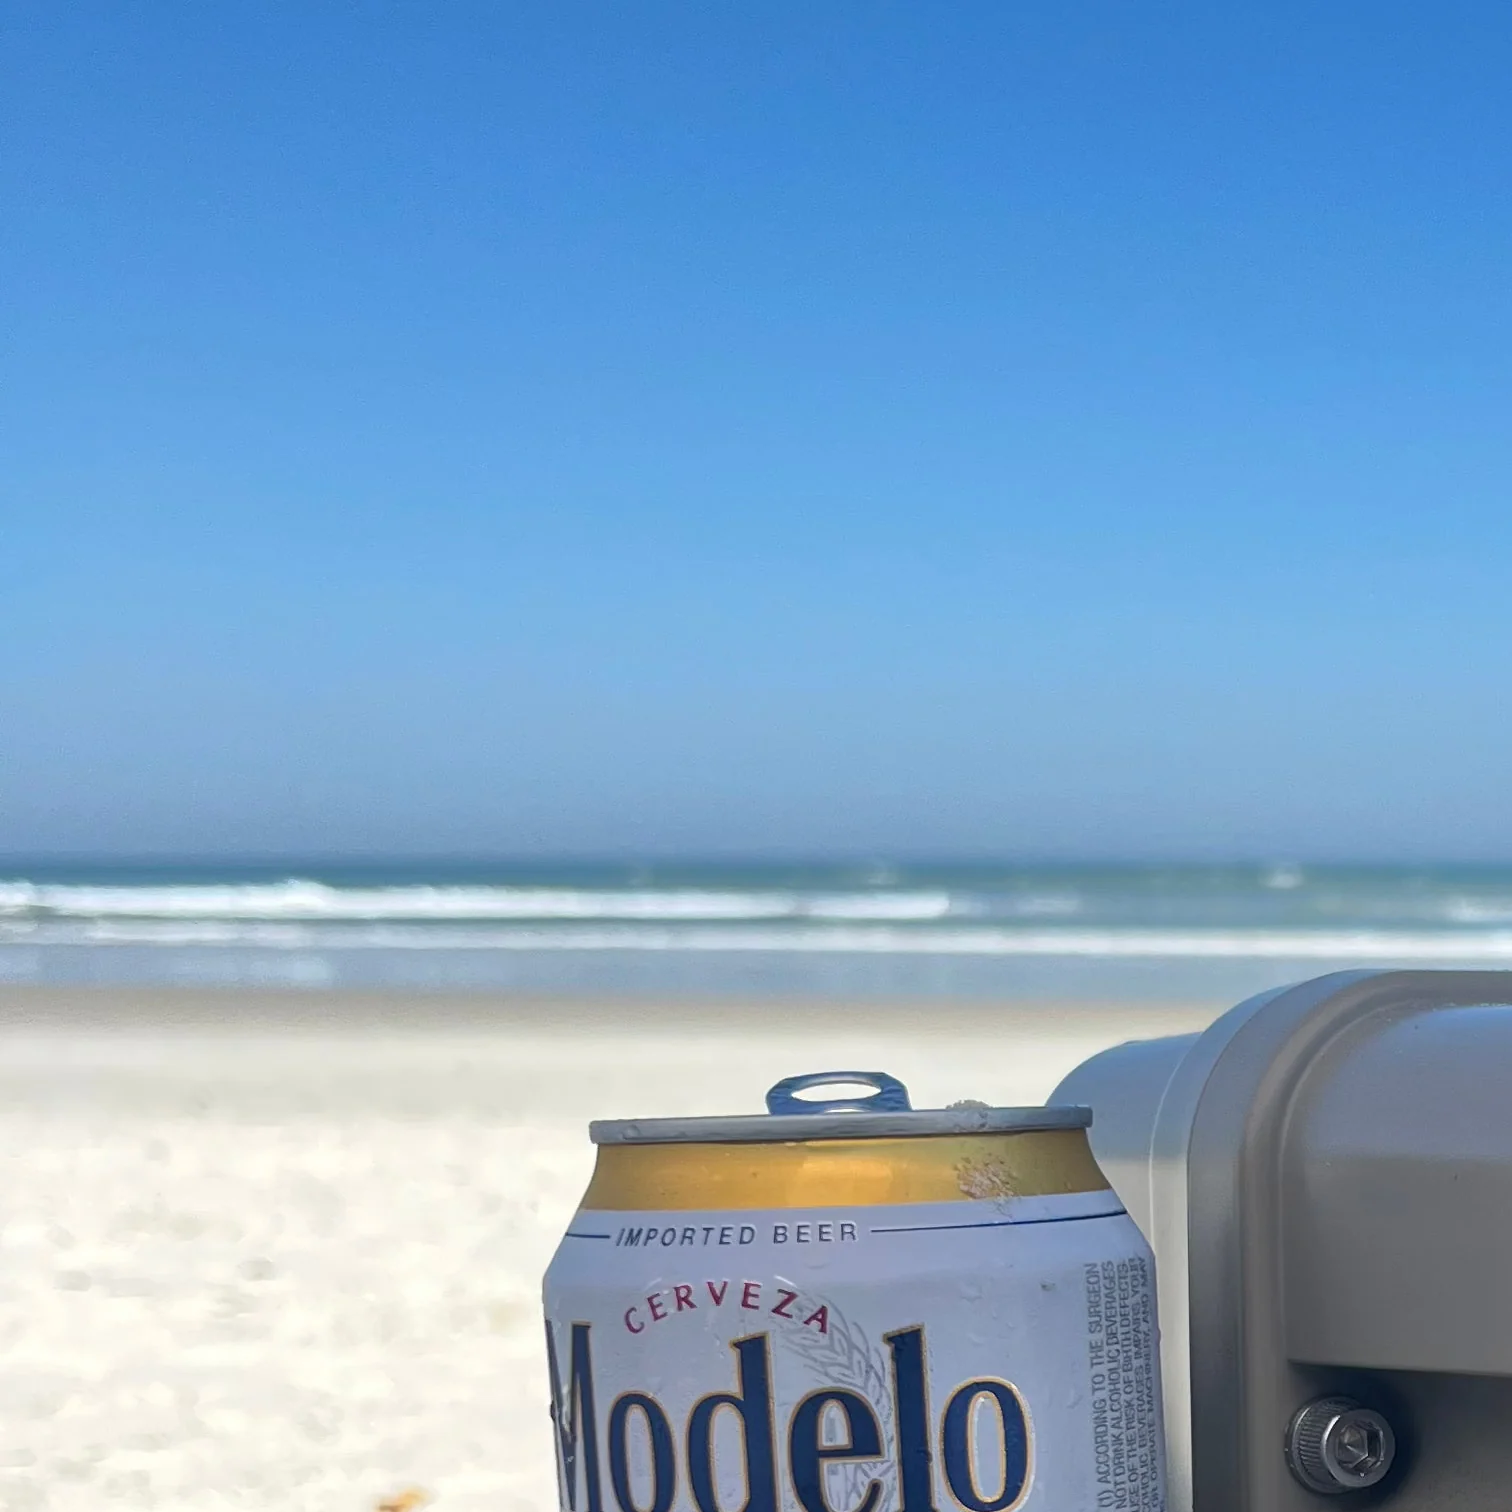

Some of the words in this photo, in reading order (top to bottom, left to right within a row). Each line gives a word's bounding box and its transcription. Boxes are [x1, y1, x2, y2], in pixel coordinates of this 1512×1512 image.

[616, 1226, 755, 1247] IMPORTED
[773, 1223, 858, 1244] BEER
[623, 1280, 829, 1334] CERVEZA
[1085, 1263, 1103, 1334] SURGEON
[1103, 1261, 1119, 1347] BEVERAGES
[1091, 1340, 1105, 1369] THE
[1093, 1374, 1106, 1395] TO
[1109, 1349, 1122, 1430] ALCOHOLIC
[1123, 1375, 1134, 1395] OF
[1093, 1399, 1111, 1484] ACCORDING
[1113, 1431, 1126, 1477] DRINK
[1127, 1431, 1138, 1459] THE
[1129, 1462, 1139, 1482] OF
[1114, 1480, 1127, 1509] NOT
